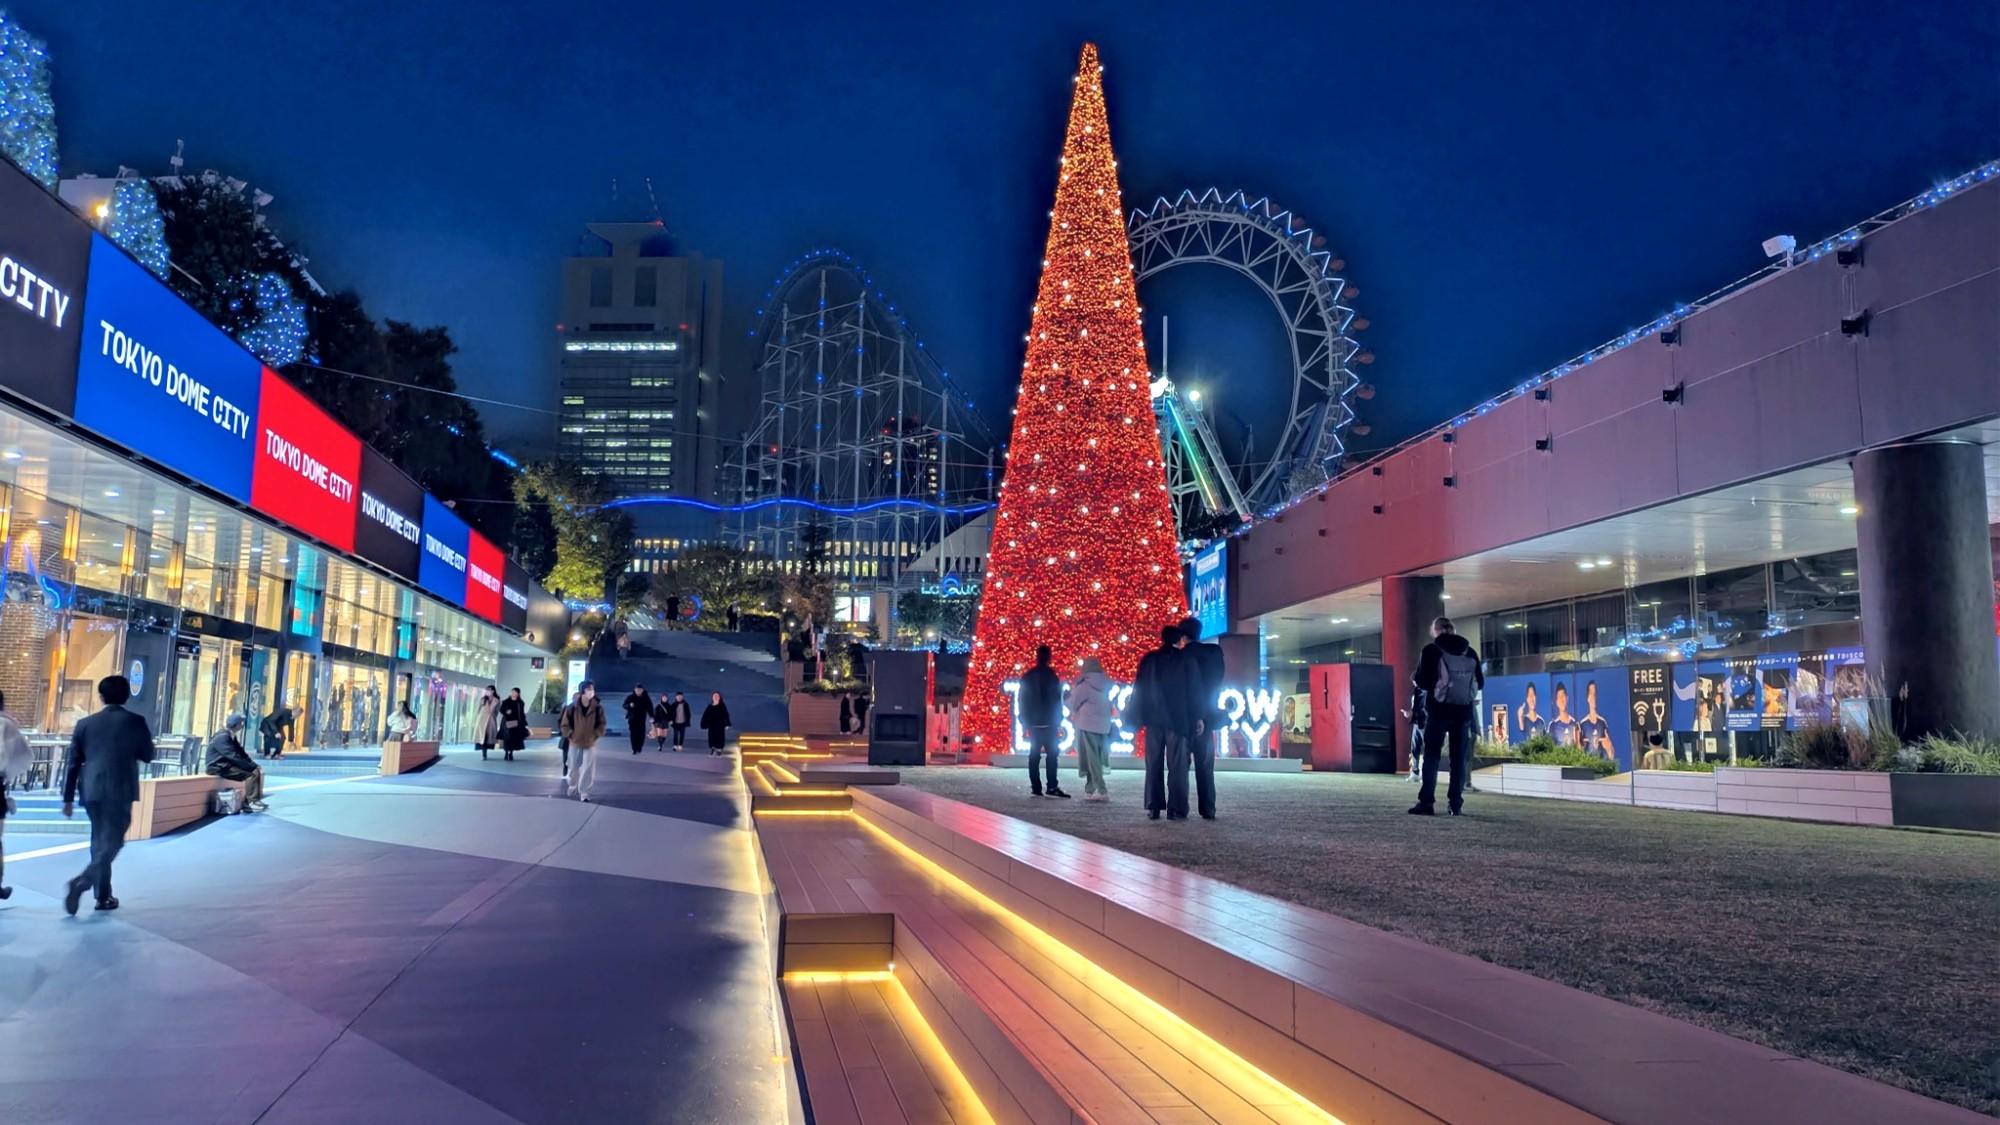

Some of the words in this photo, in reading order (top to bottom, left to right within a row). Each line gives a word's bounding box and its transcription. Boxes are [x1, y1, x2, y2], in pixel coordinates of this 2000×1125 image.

[0, 257, 69, 328] CITY
[100, 319, 163, 386] TOKYO
[166, 364, 210, 417] DOME
[212, 395, 250, 440] CITY
[265, 428, 301, 472] TOKYO
[302, 453, 329, 490] DOME
[329, 472, 353, 503] CITY
[362, 491, 386, 523] TOKYO
[385, 507, 404, 535] DOME
[403, 520, 420, 545] CITY
[425, 533, 442, 558] TOKYO
[1633, 668, 1663, 684] FREE
